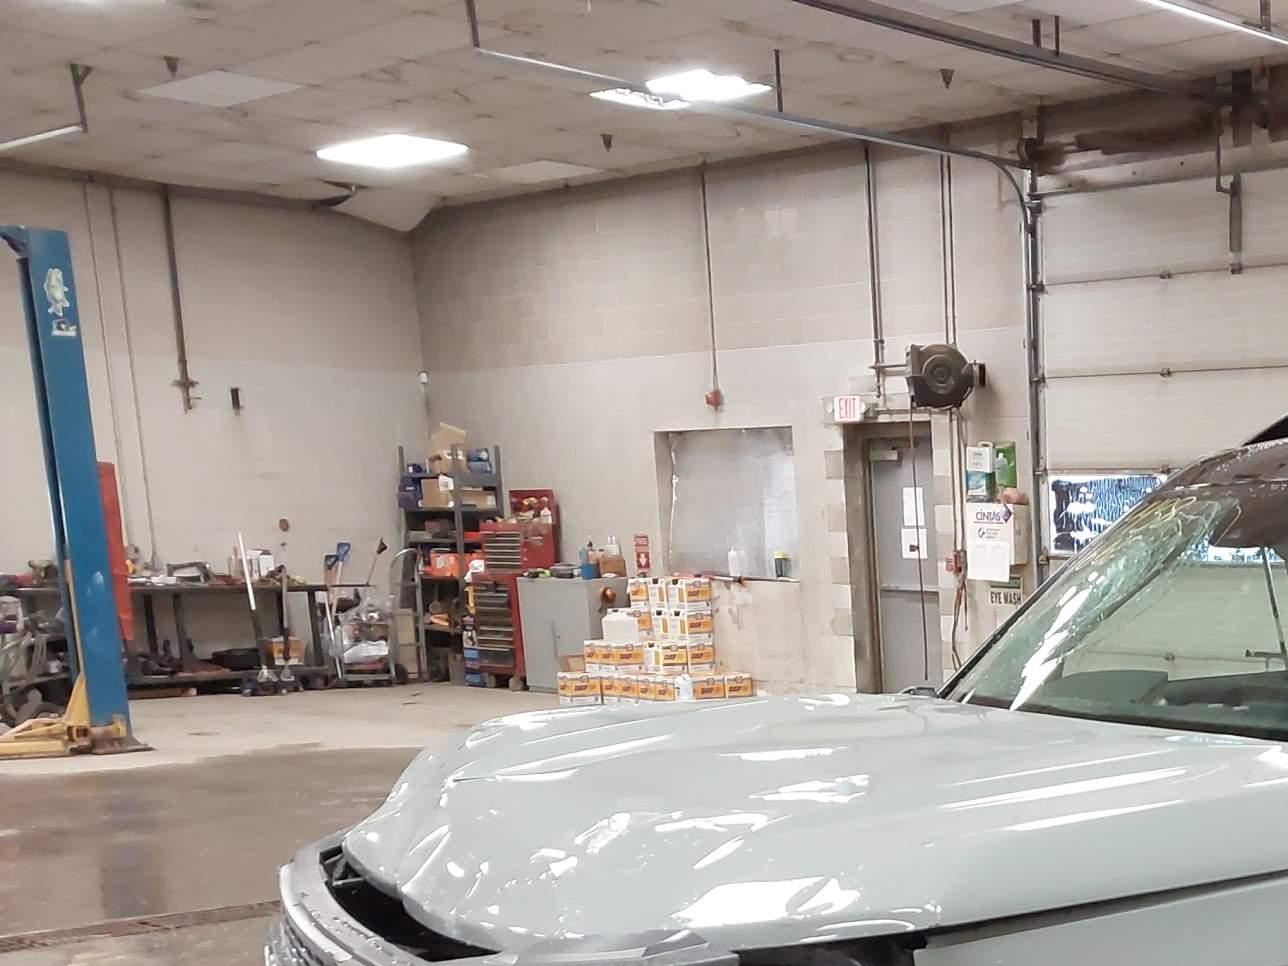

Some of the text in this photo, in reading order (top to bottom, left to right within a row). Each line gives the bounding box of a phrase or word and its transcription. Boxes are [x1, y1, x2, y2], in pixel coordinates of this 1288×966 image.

[838, 397, 857, 419] EXIT
[990, 591, 1022, 606] EYE WASH
